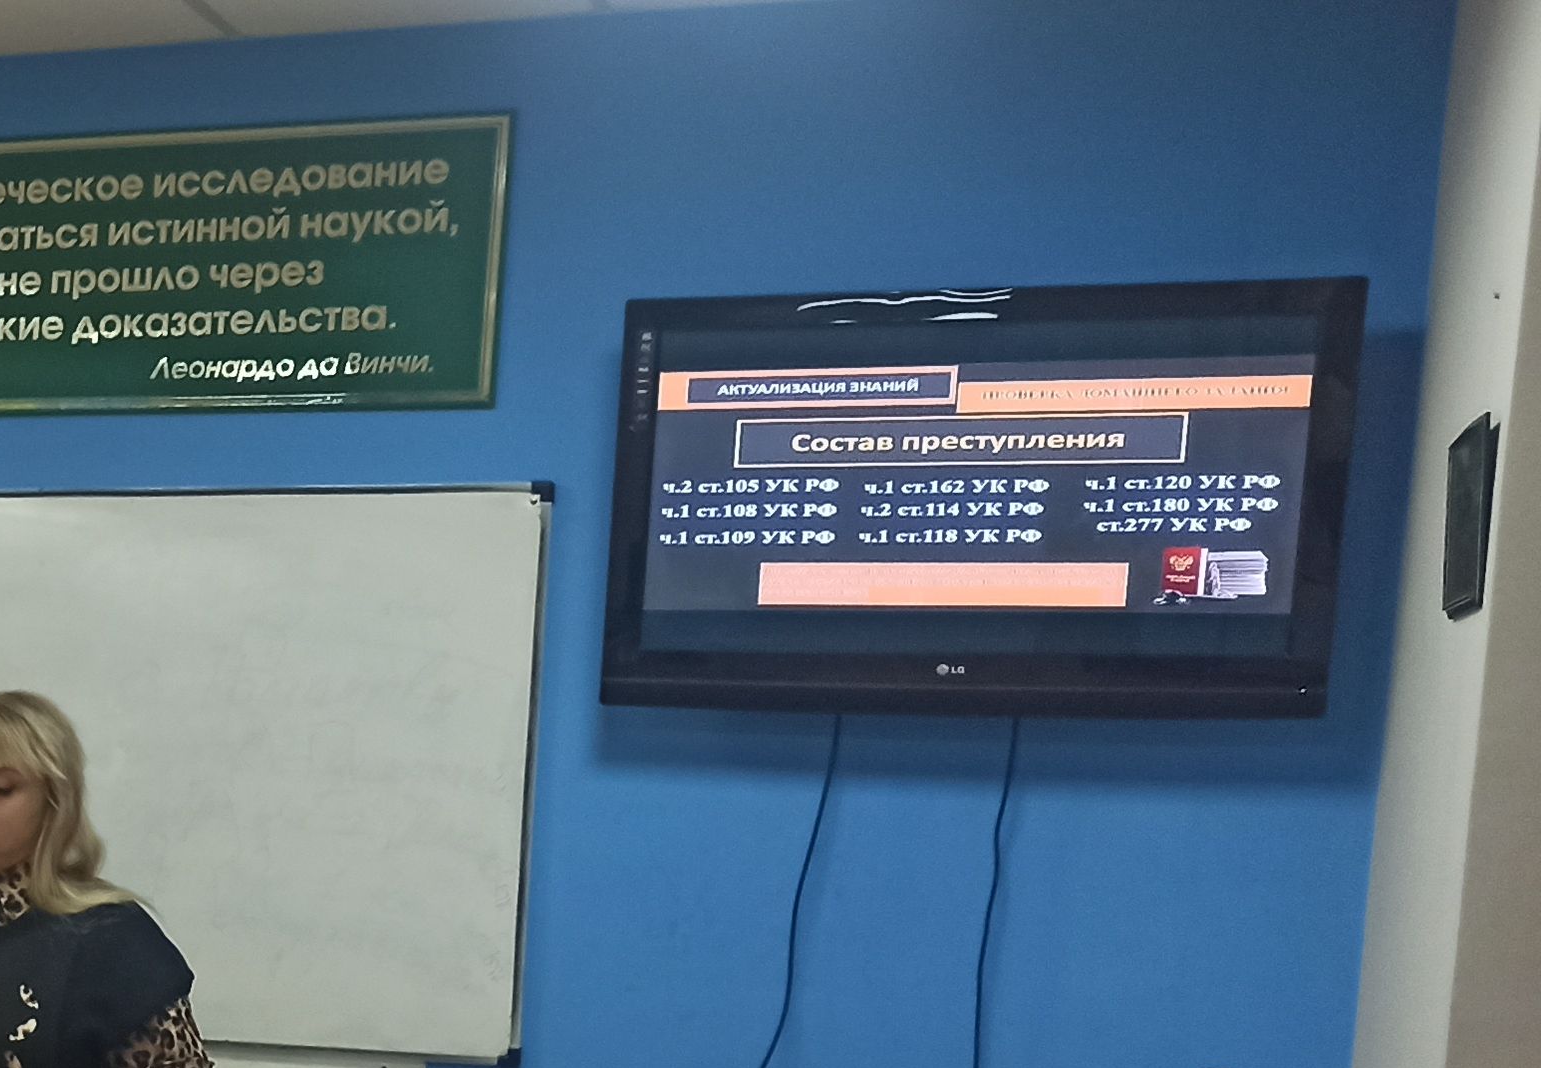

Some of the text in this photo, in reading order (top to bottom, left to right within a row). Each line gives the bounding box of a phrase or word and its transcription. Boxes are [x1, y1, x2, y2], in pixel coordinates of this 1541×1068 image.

[153, 156, 450, 198] исследование
[108, 208, 291, 247] истинной
[298, 201, 459, 241] наукой,
[50, 262, 202, 299] прошло
[210, 257, 326, 295] через
[72, 303, 396, 347] доказательства.
[149, 349, 436, 384] Леонардо да Винчи.
[717, 377, 919, 397] АКТУАЛИЗАЦИЯ ЗНАНИЙ
[791, 432, 1126, 455] Состав преступления
[663, 478, 840, 494] ч.2 ст.105 УК РФ
[864, 479, 1050, 495] ч.1 ст.162 УК РФ
[1085, 474, 1281, 490] ч.1 ст.120 УК РФ
[661, 503, 838, 519] ч.1 ст.108 УК РФ
[860, 502, 1045, 517] ч.2 ст.114 УК РФ
[1083, 497, 1279, 513] ч.1 ст.180 УК РФ
[1096, 517, 1252, 533] ст.277 УК РФ
[659, 530, 836, 545] ч.1 ст.109 УК РФ
[858, 528, 1043, 544] ч.1 ст.118 УК РФ
[951, 665, 965, 674] LG
